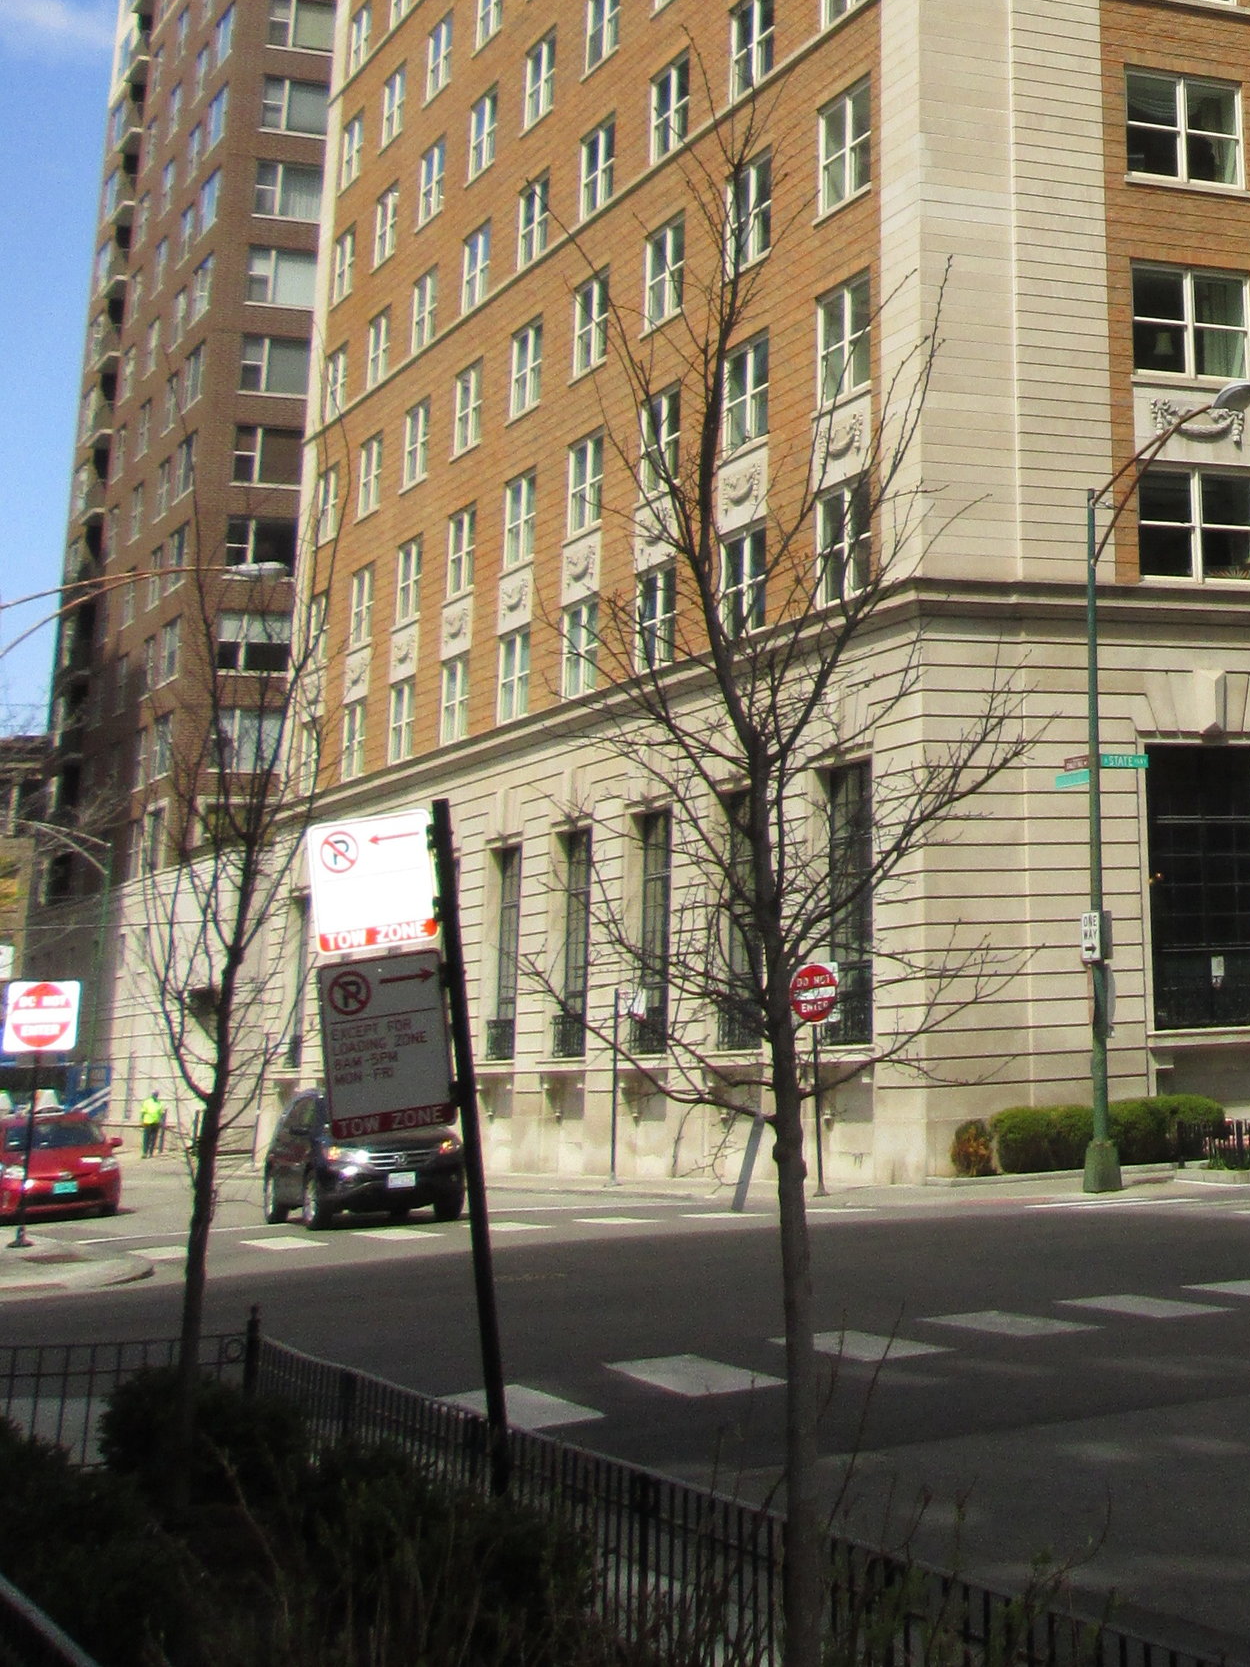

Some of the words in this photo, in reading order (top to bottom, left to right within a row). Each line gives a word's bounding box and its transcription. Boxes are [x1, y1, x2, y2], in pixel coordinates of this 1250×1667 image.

[1109, 755, 1133, 767] STATE
[1083, 915, 1097, 927] ONE
[326, 930, 367, 950] TOW
[376, 919, 428, 944] ZONE
[1083, 929, 1097, 940] WAY
[20, 1024, 60, 1036] ENTER
[331, 1022, 379, 1041] EXCEPT
[386, 1018, 412, 1033] FOR
[332, 1036, 387, 1057] LOADING
[394, 1030, 428, 1048] ZONE
[334, 1070, 363, 1085] MON
[338, 1115, 381, 1137] TOW
[391, 1106, 444, 1130] ZONE
